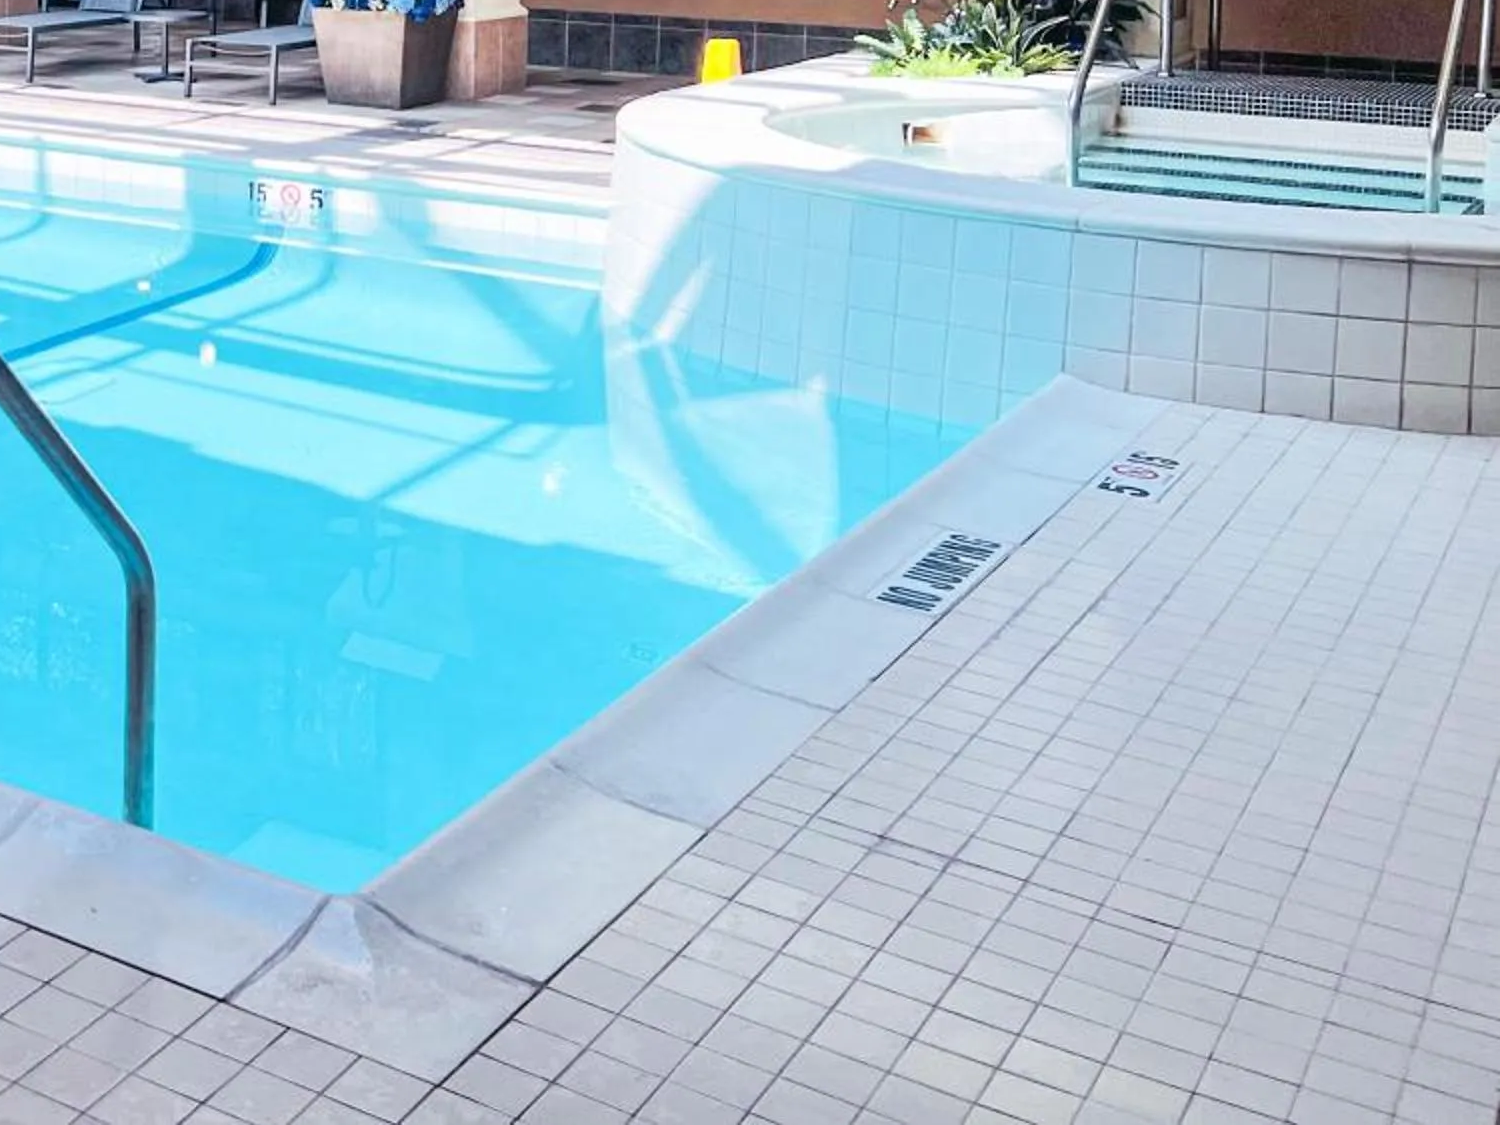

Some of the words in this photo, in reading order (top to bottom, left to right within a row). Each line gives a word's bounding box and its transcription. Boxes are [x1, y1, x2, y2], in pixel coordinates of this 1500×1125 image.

[1097, 482, 1150, 497] 5
[902, 534, 1001, 590] JUMPING
[876, 586, 943, 612] NO
